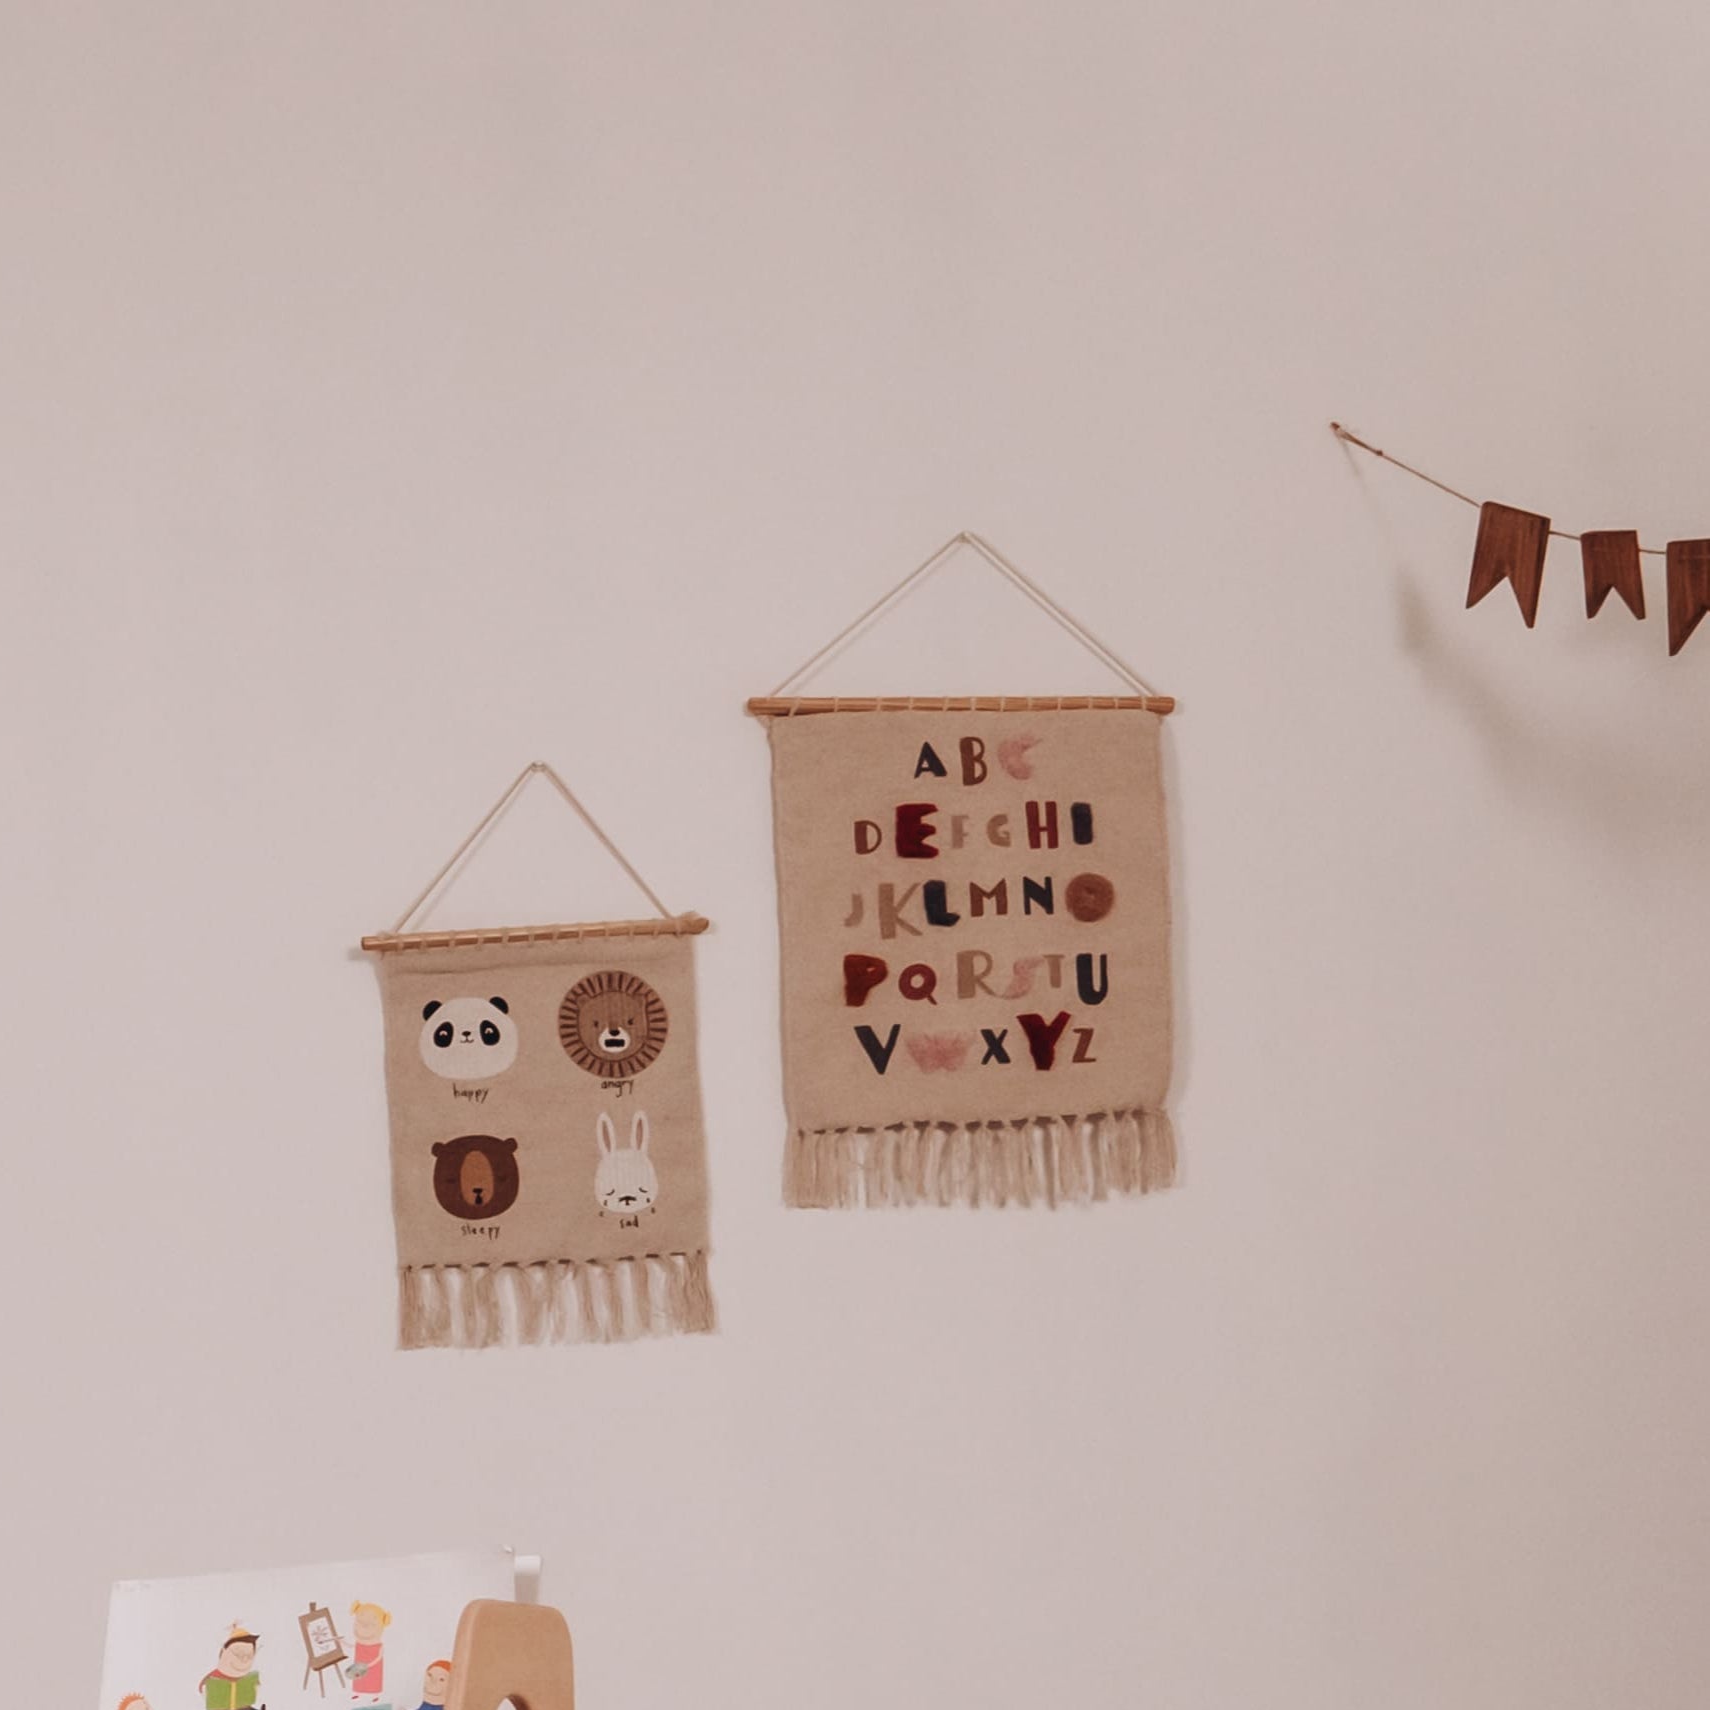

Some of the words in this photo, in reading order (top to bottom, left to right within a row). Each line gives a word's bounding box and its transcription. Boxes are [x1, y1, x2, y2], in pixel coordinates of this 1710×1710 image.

[452, 1083, 490, 1104] happy
[600, 1079, 636, 1098] angry
[619, 1215, 640, 1229] sad
[461, 1223, 501, 1240] sleepy
